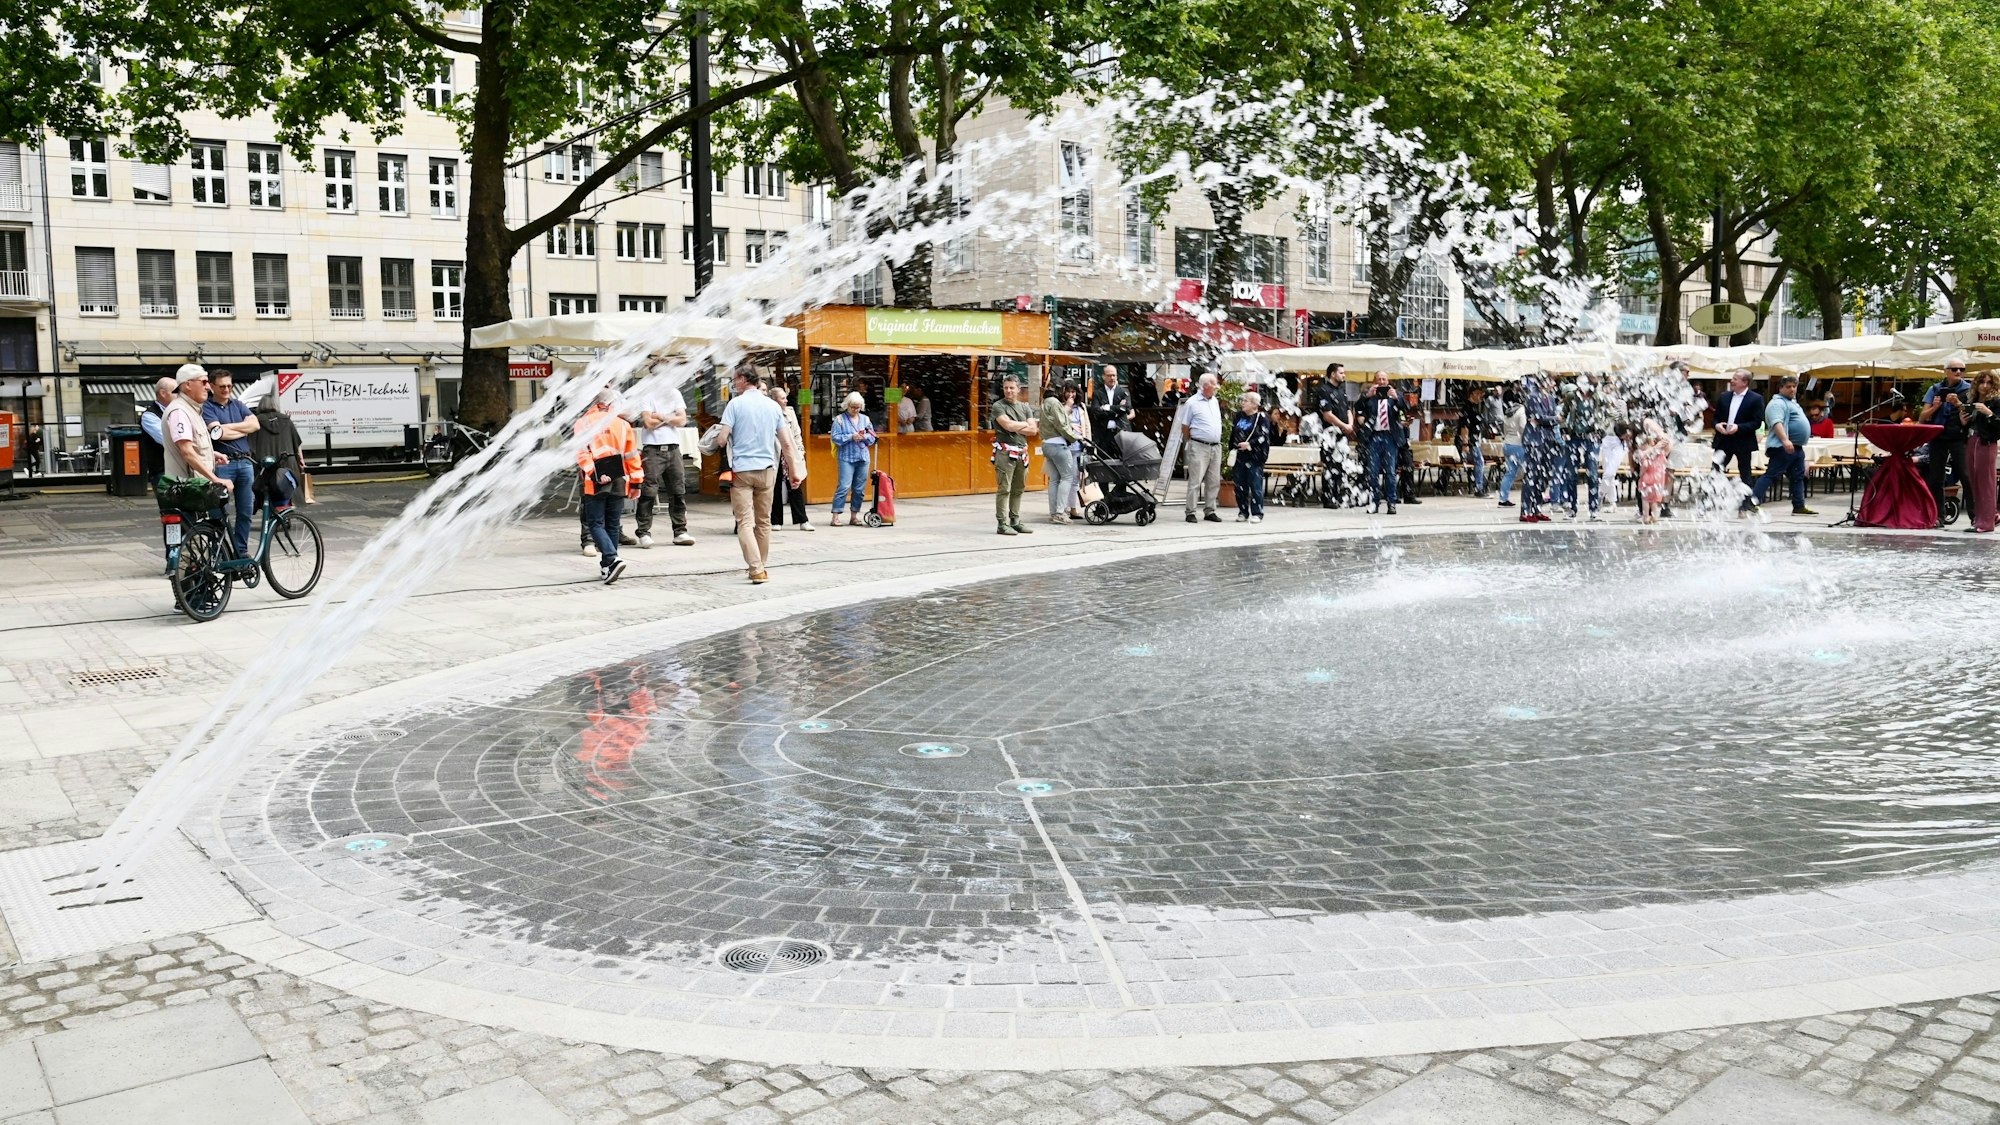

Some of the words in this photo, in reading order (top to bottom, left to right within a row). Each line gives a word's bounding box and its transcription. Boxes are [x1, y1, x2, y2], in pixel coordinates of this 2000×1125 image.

[868, 317, 918, 336] Original
[921, 318, 1001, 335] Flammkuchen
[331, 382, 410, 397] MBN-Technik
[176, 422, 185, 434] 3
